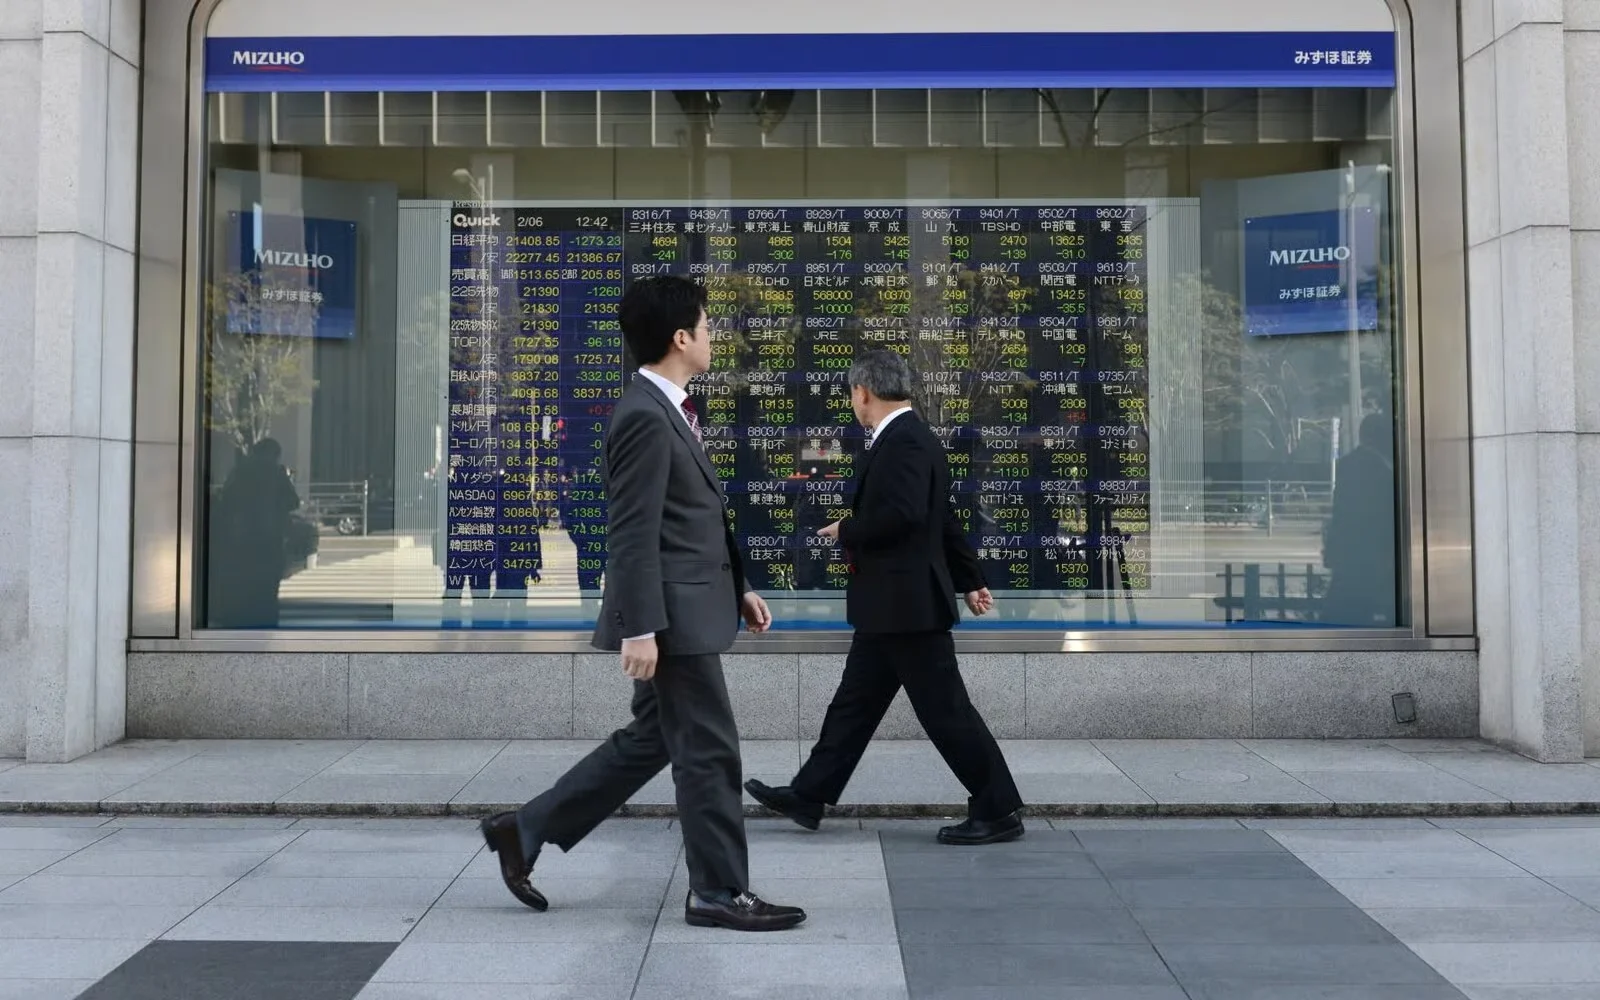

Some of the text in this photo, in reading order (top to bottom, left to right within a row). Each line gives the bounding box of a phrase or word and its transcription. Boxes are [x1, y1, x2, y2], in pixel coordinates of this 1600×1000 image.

[233, 51, 305, 65] MIZUHO
[1294, 50, 1372, 65] みずほ証券
[632, 210, 671, 220] 8316/T
[689, 210, 729, 220] 8439/T
[747, 210, 788, 220] 8766/T
[805, 209, 846, 219] 8929/T
[921, 209, 961, 219] 9065/T
[979, 208, 1019, 219] 9401/T
[1038, 208, 1078, 218] 9502/T
[1096, 208, 1136, 218] 9602/T
[453, 213, 608, 228] Quick 2/06 12:42
[629, 222, 676, 234] 三井住友
[744, 222, 792, 233] 東京海上
[803, 221, 850, 233] 青山財産
[980, 222, 1021, 231] TBSHD
[1040, 221, 1076, 233] 中部電
[452, 234, 621, 247] 日経平均 21408.85 -1273.23
[652, 236, 678, 247] 4694
[709, 236, 737, 247] 5800
[826, 236, 852, 246] 1504
[1000, 236, 1028, 246] 2470
[254, 249, 334, 269] MIZUHO
[505, 252, 621, 263] 22277.45 21386.67
[652, 250, 676, 260] -241
[710, 250, 737, 260] -150
[768, 250, 794, 260] -302
[826, 250, 852, 260] -176
[884, 250, 910, 260] -145
[949, 249, 969, 260] -40
[1001, 249, 1027, 259] -139
[1269, 246, 1351, 266] MIZUHO
[631, 263, 671, 274] 8331/T
[689, 263, 730, 274] 8591/T
[747, 263, 788, 274] 8795/T
[805, 263, 845, 274] 8951/T
[863, 263, 904, 273] 9020/T
[922, 263, 962, 273] 9101/T
[980, 263, 1020, 273] 9412/T
[1038, 262, 1078, 273] 9503/T
[1096, 262, 1137, 273] 9613/T
[581, 269, 621, 279] 205.85
[859, 275, 909, 287] JR東日本
[1040, 275, 1077, 287] 関西電
[262, 288, 323, 303] みずほ証券
[523, 286, 560, 297] 21390
[587, 286, 621, 296] -1260
[1050, 290, 1085, 300] 1342.5
[1279, 285, 1341, 300] みずほ証券
[523, 303, 559, 313] 21830
[813, 304, 853, 314] -10000
[1057, 303, 1085, 313] -35.5
[523, 320, 559, 330] 21390
[806, 318, 846, 327] 8952/T
[864, 317, 904, 327] 9021/T
[922, 317, 962, 327] 9104/T
[980, 317, 1020, 327] 9413/T
[1039, 317, 1078, 327] 9504/T
[750, 330, 787, 341] 三井不
[814, 331, 839, 340] JRE
[860, 330, 909, 341] JR西日本
[919, 330, 967, 341] 商船三井
[1042, 329, 1077, 341] 中国電
[451, 337, 492, 348] TOPIX
[583, 337, 621, 347] -96.19
[813, 345, 853, 354] 540000
[574, 354, 621, 364] 1725.74
[1002, 358, 1028, 368] -102
[1072, 358, 1085, 368] -7
[747, 372, 787, 382] 8802/T
[806, 372, 846, 382] 9001/T
[1040, 371, 1080, 381] 9511/T
[1098, 371, 1138, 381] 9735/T
[689, 384, 730, 395] 野村HD
[989, 385, 1014, 394] NTT
[1103, 384, 1132, 394] セコム
[833, 413, 852, 423] -55
[1002, 412, 1028, 422] -134
[748, 427, 787, 436] 8803/T
[981, 427, 1021, 436] 9433/T
[1040, 426, 1080, 436] 9531/T
[450, 438, 497, 449] ユーロ/円
[750, 439, 785, 450] 平和不
[986, 440, 1018, 449] KDDI
[1043, 439, 1077, 450] 東ガス
[768, 454, 793, 463] 1965
[748, 481, 787, 491] 8804/T
[806, 481, 846, 491] 9007/T
[981, 481, 1022, 491] 9437/T
[449, 490, 495, 501] NASDAQ
[808, 493, 844, 505] 小田急
[768, 509, 793, 518] 1664
[982, 536, 1022, 546] 9501/T
[750, 549, 785, 560] 住友不
[977, 549, 1028, 560] 東電力HD
[449, 558, 496, 569] ムンバイ
[1009, 564, 1029, 574] 422
[1010, 578, 1029, 588] -22
